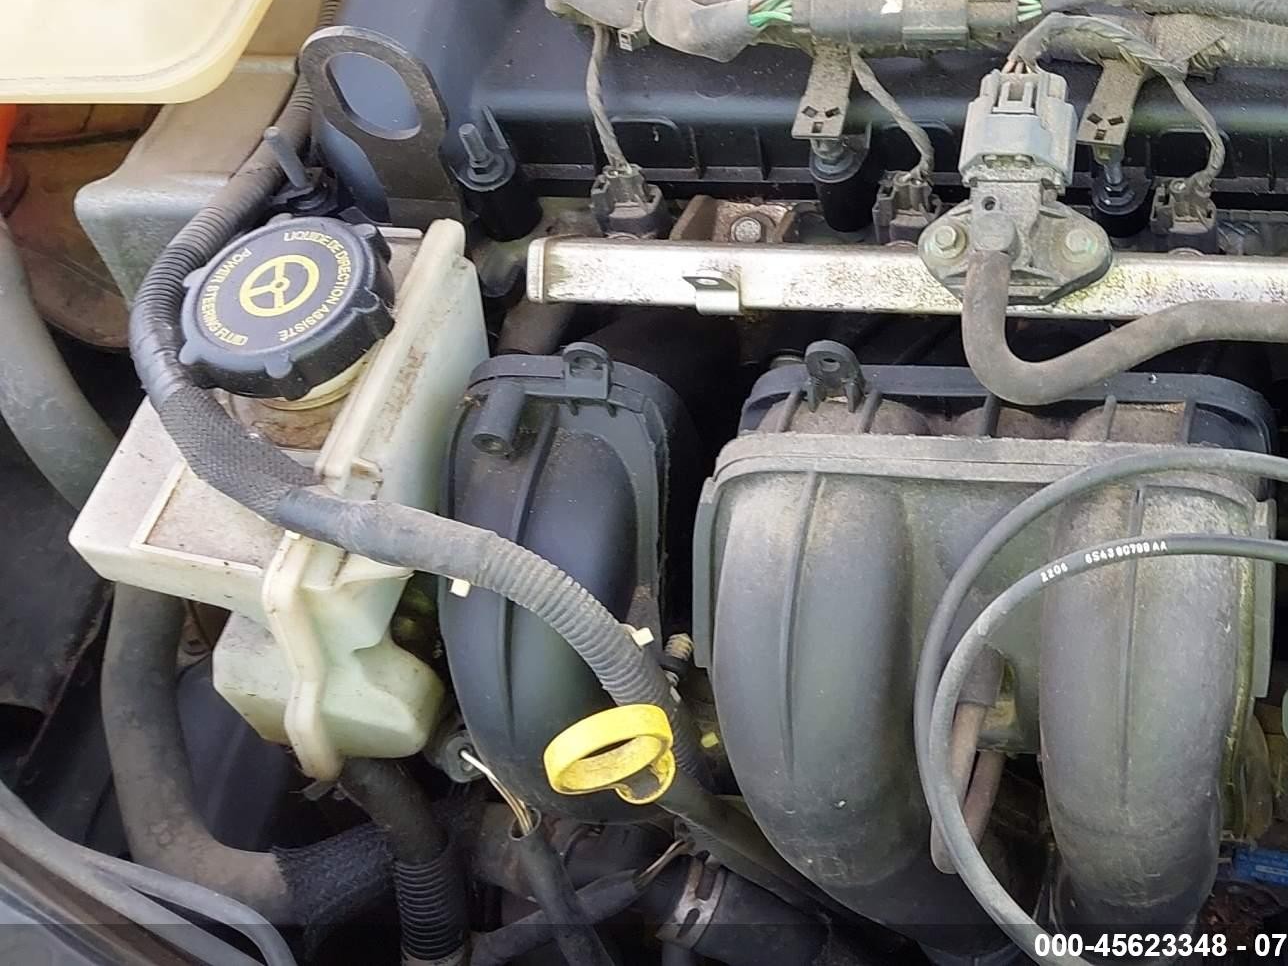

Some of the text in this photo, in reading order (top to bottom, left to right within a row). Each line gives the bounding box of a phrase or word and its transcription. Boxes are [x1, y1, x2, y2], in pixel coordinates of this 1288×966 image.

[283, 231, 333, 246] LIQUIDE
[326, 239, 345, 254] DE
[326, 250, 352, 305] DIRECTION
[202, 247, 253, 346] POWER STEERING FLUID
[1040, 562, 1069, 583] 2206
